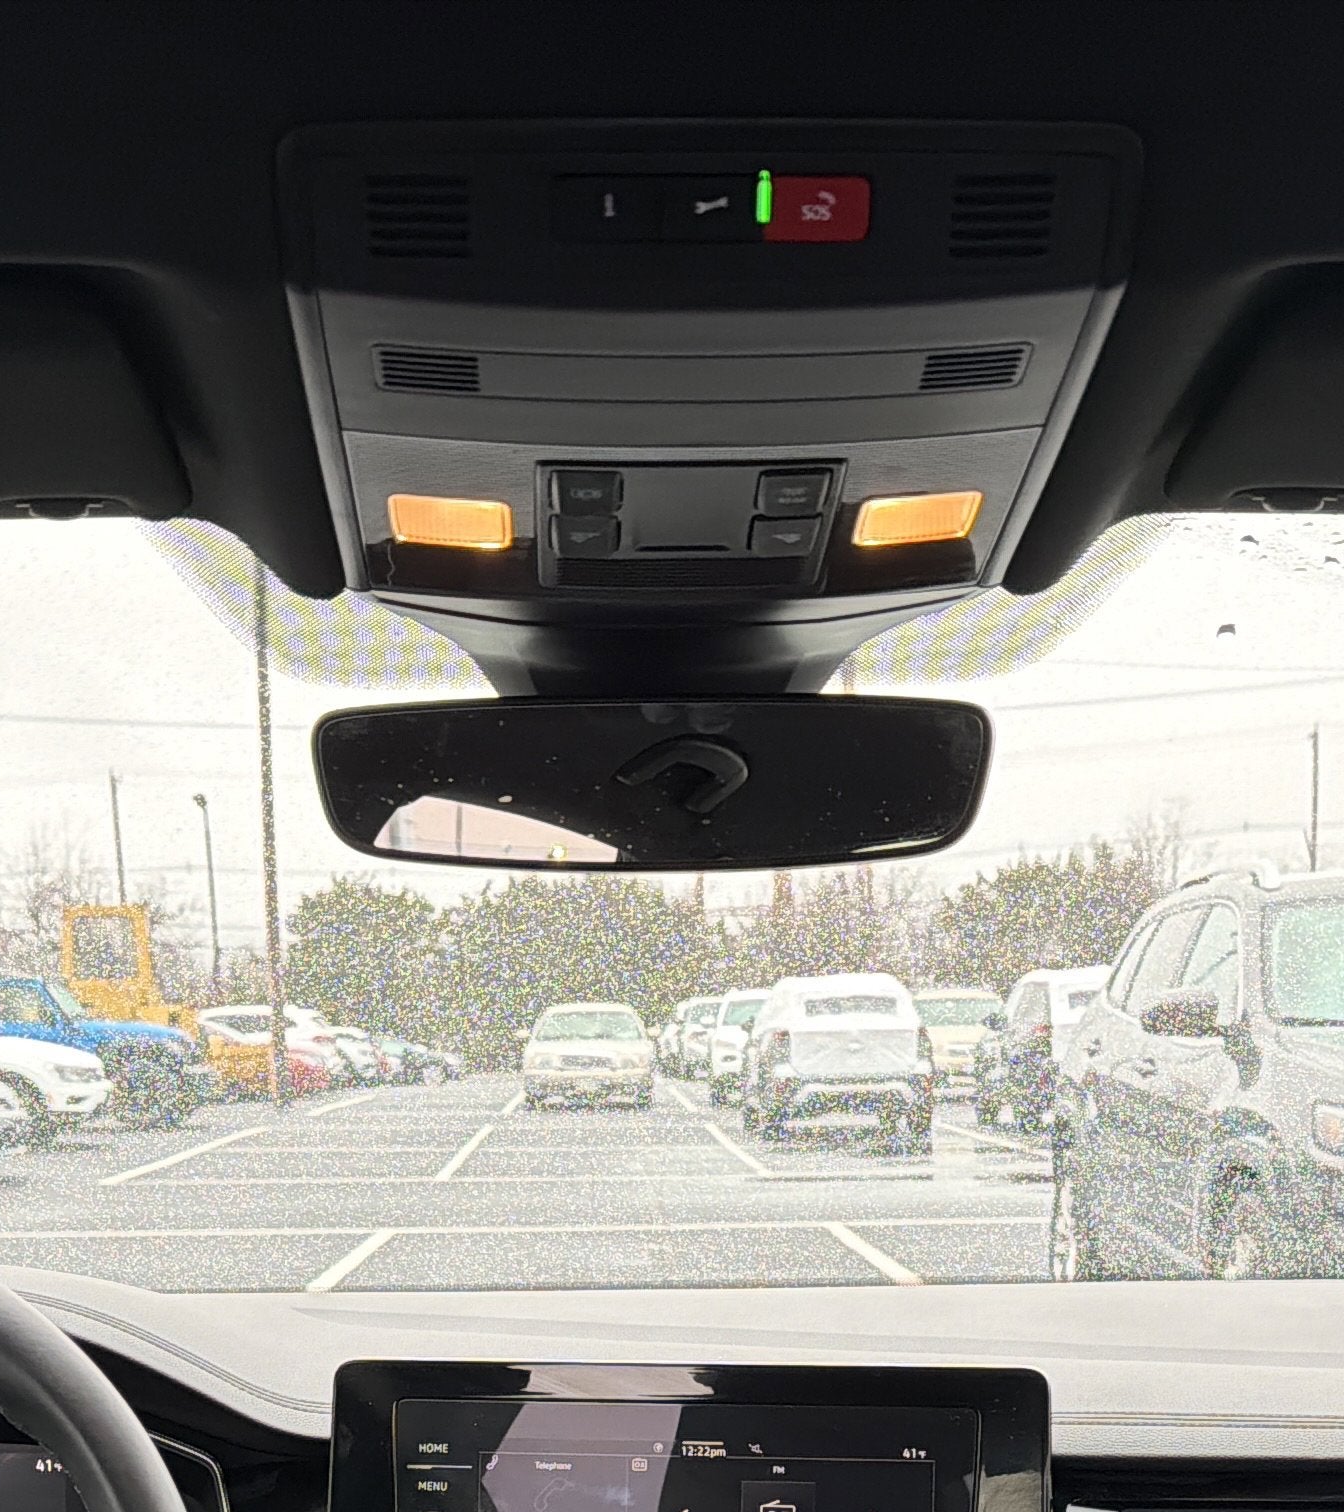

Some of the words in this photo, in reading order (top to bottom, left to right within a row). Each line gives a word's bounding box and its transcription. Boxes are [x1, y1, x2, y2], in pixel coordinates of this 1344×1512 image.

[801, 204, 832, 221] SOS
[418, 1443, 448, 1454] HOME
[681, 1446, 727, 1459] 12:22pm
[535, 1461, 572, 1471] Telephone
[772, 1465, 785, 1475] FM
[418, 1481, 448, 1492] MENU
